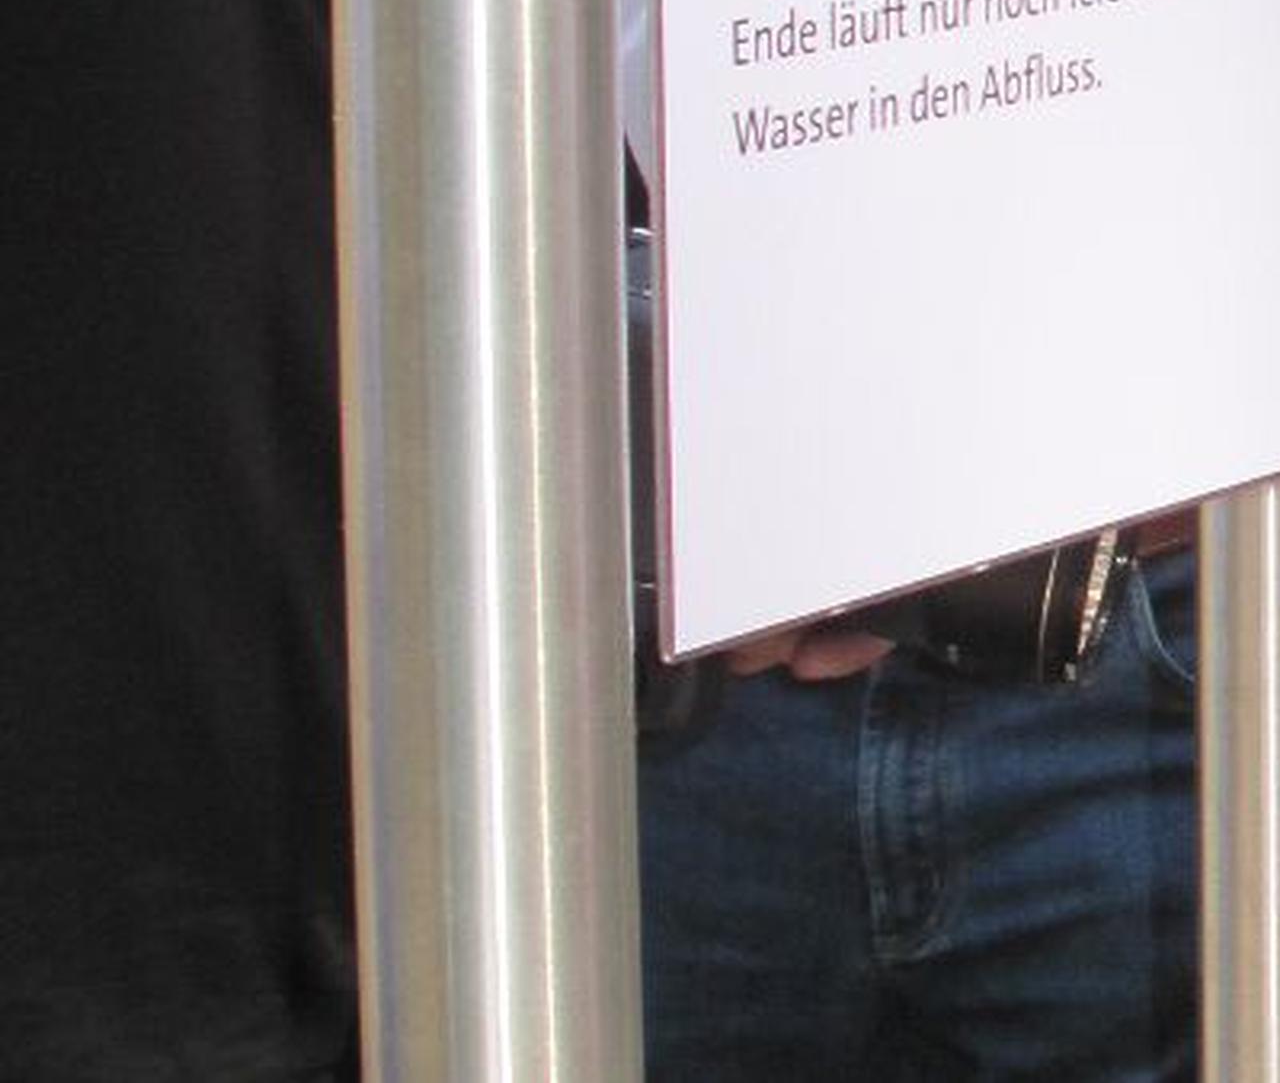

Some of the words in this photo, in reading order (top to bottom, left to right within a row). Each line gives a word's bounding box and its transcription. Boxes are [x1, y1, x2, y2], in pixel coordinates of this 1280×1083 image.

[731, 7, 818, 67] Ende
[731, 100, 859, 157] Wasser
[869, 85, 899, 131] in
[909, 73, 971, 125] den
[978, 52, 1103, 111] Abfluss.
